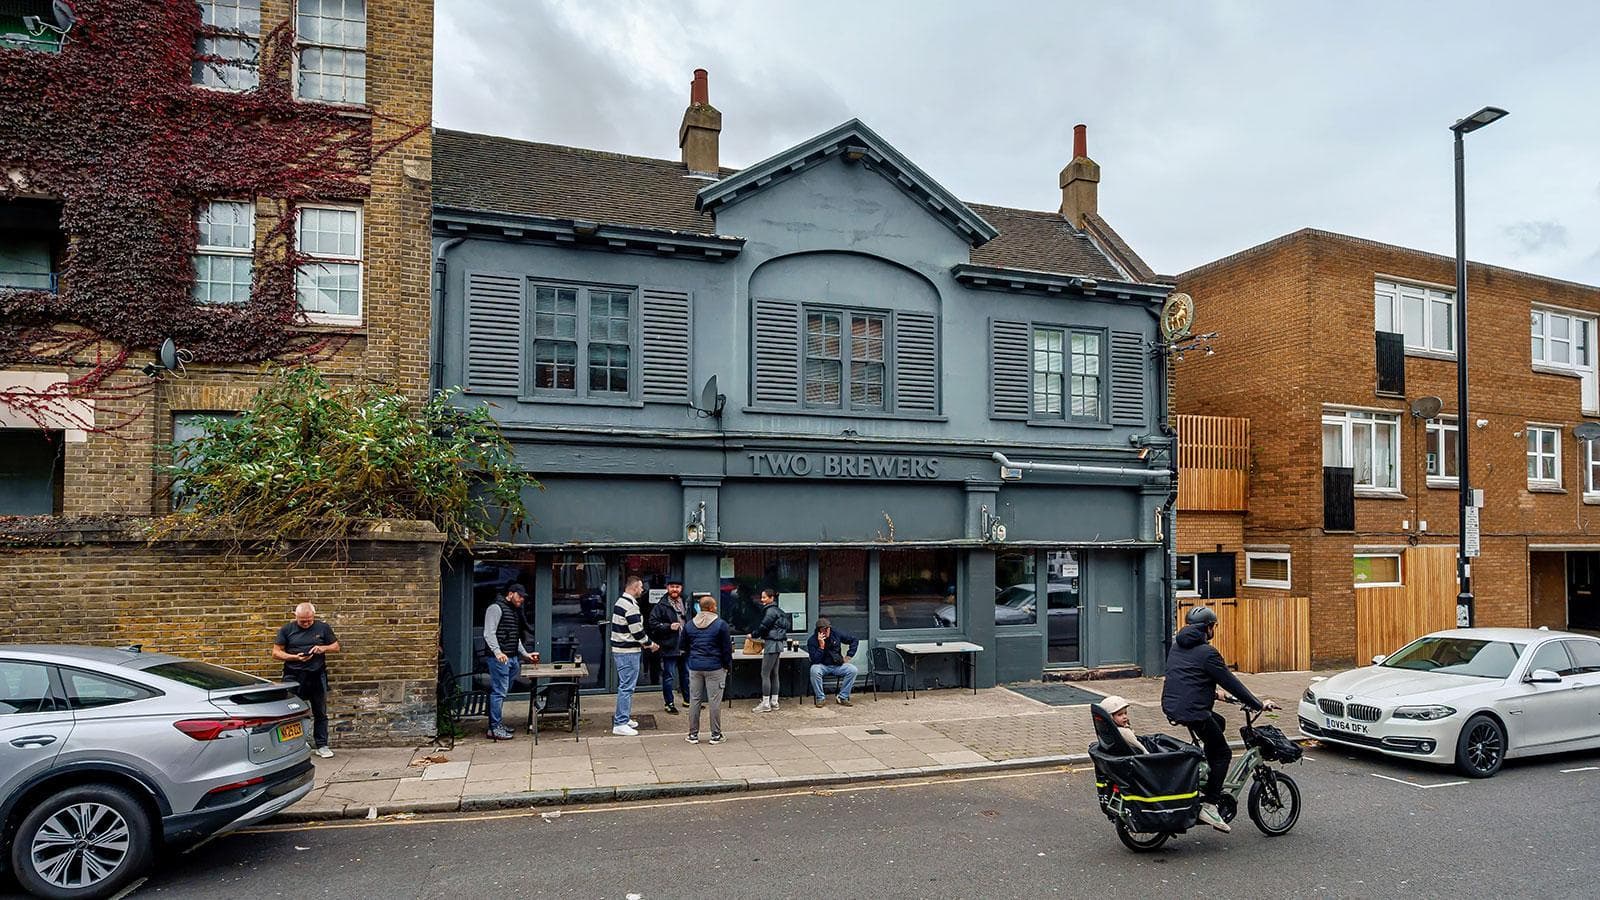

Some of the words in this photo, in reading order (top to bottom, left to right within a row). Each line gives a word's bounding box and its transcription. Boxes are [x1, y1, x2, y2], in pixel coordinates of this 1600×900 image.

[748, 453, 813, 476] TWO
[823, 454, 941, 479] BREWERS
[1351, 723, 1369, 733] DFK
